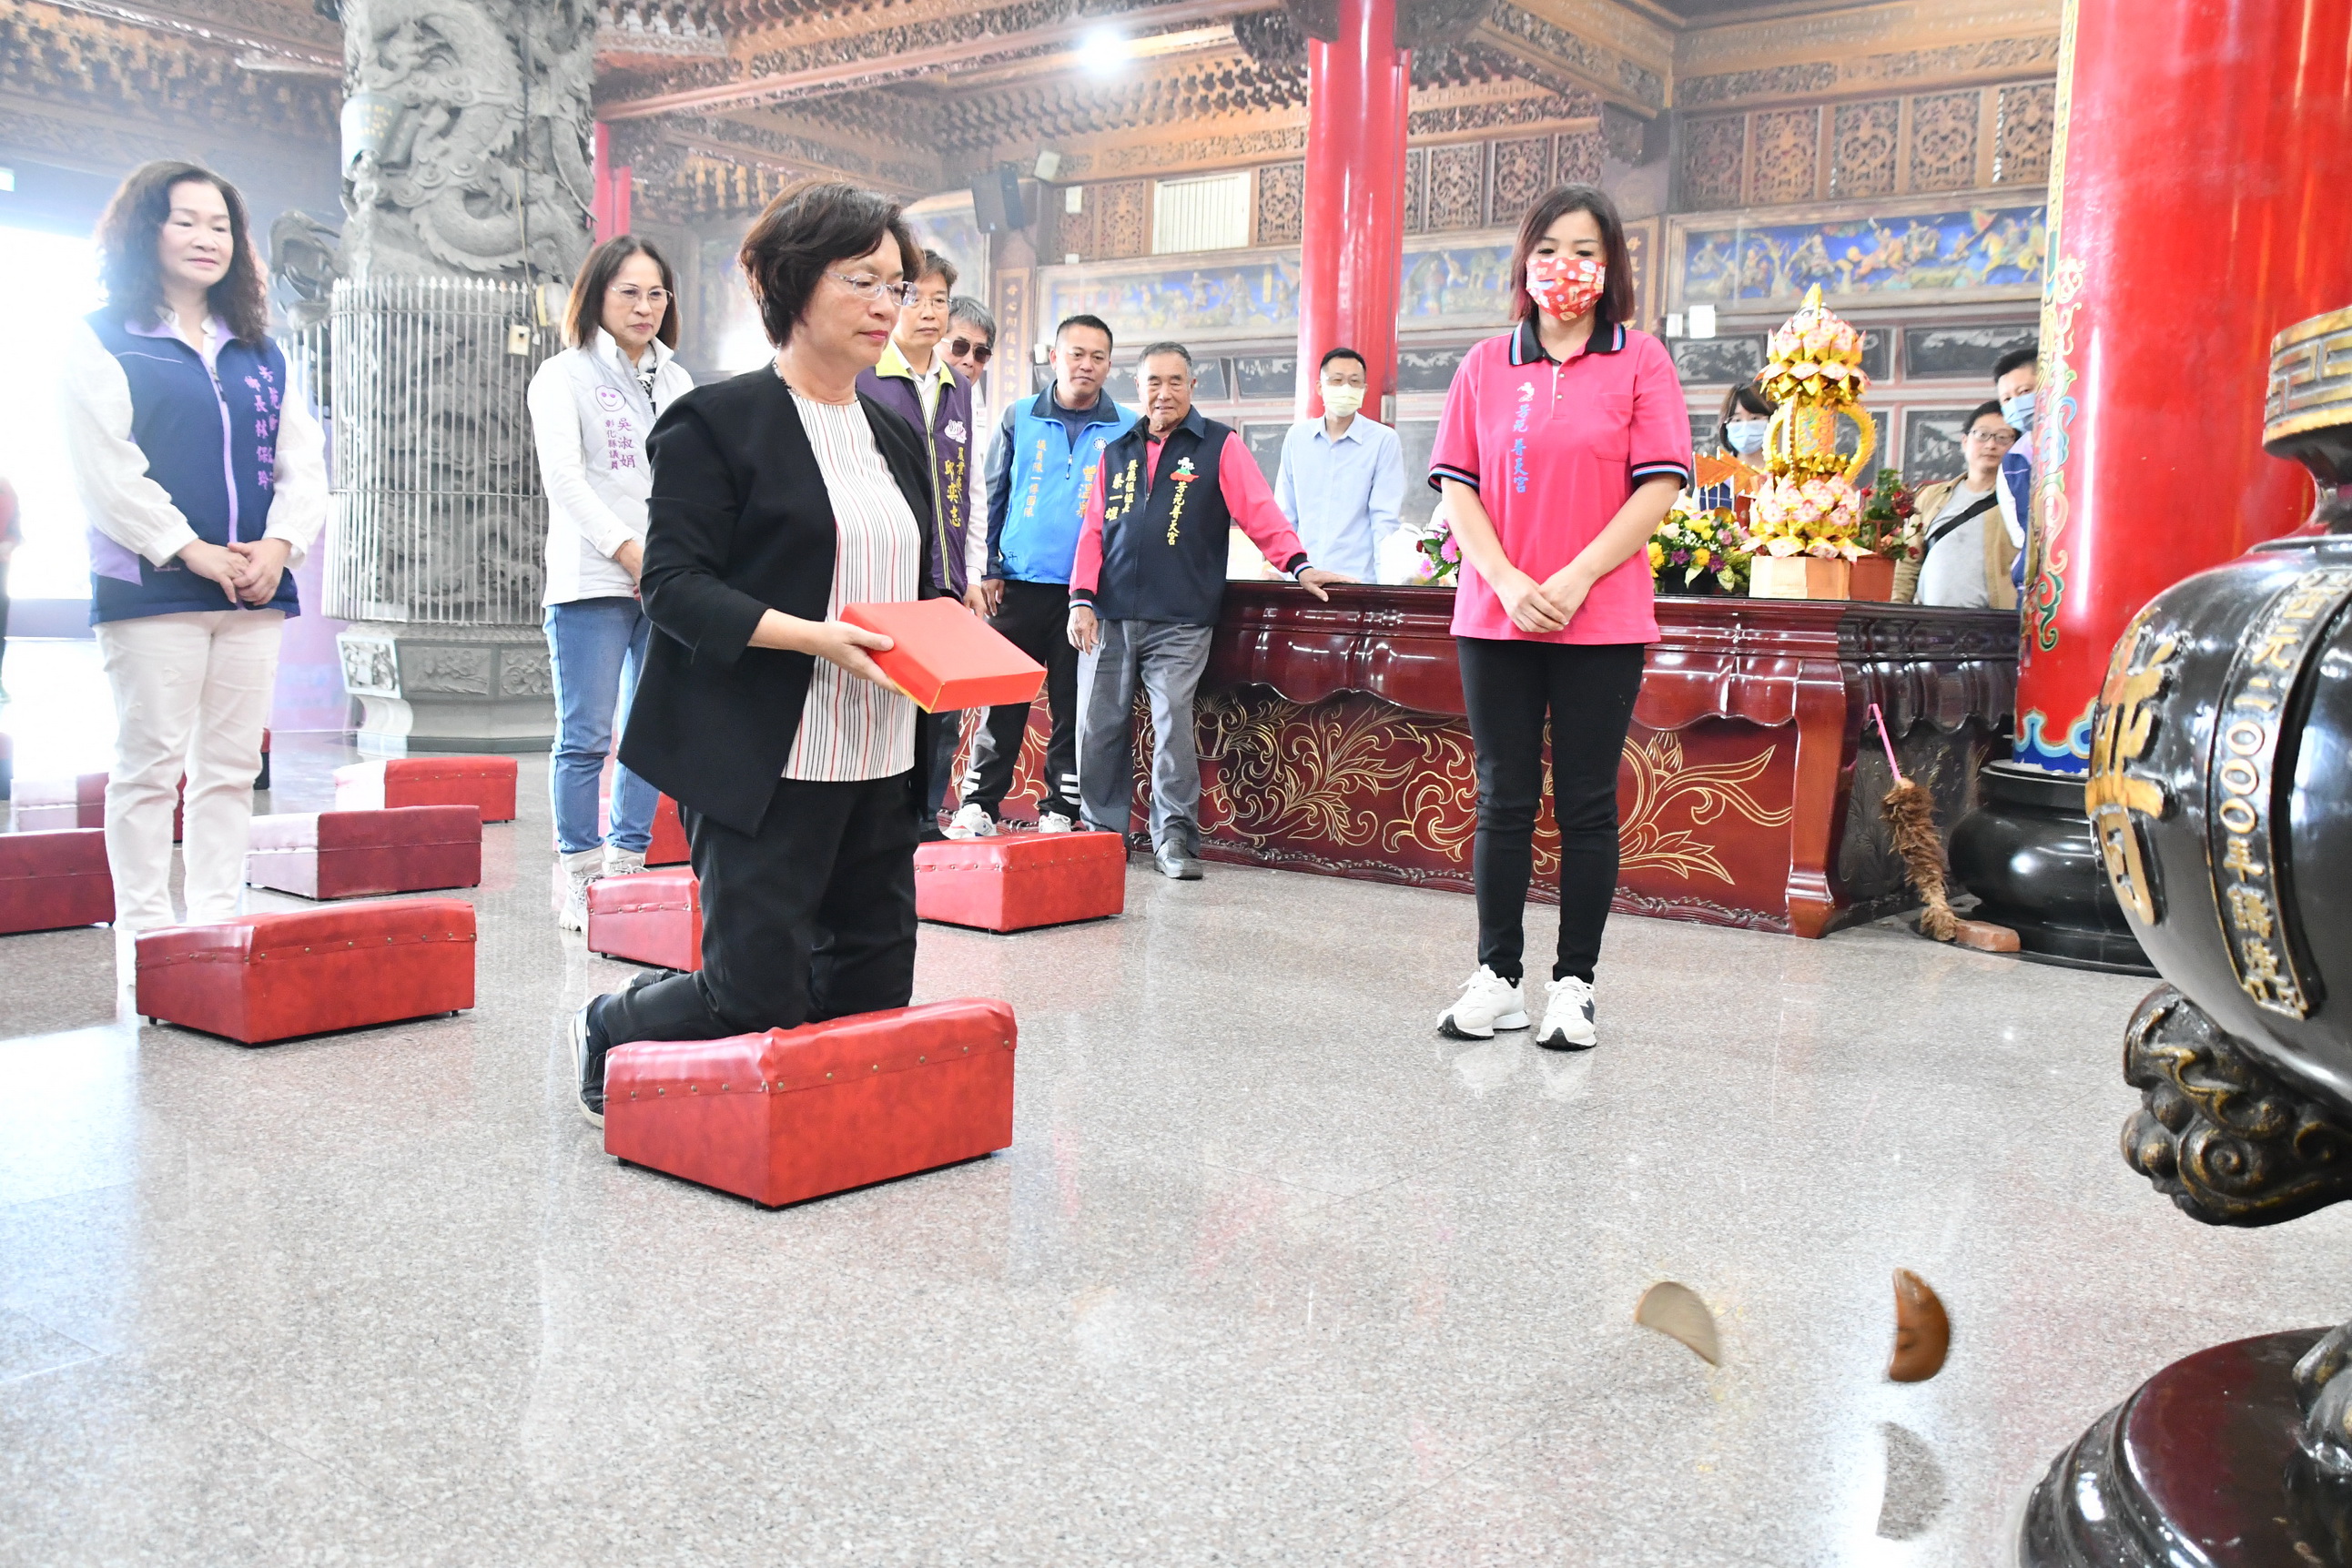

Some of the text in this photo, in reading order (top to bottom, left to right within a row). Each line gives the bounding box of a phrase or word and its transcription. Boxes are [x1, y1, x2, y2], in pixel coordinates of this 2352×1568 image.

[604, 419, 619, 470] 彰化縣議員
[618, 417, 635, 469] 吳淑娟
[1511, 403, 1532, 493] 芳苑普天宮
[944, 459, 961, 528] 邱奕志
[1166, 481, 1189, 546] 芳苑普天宮
